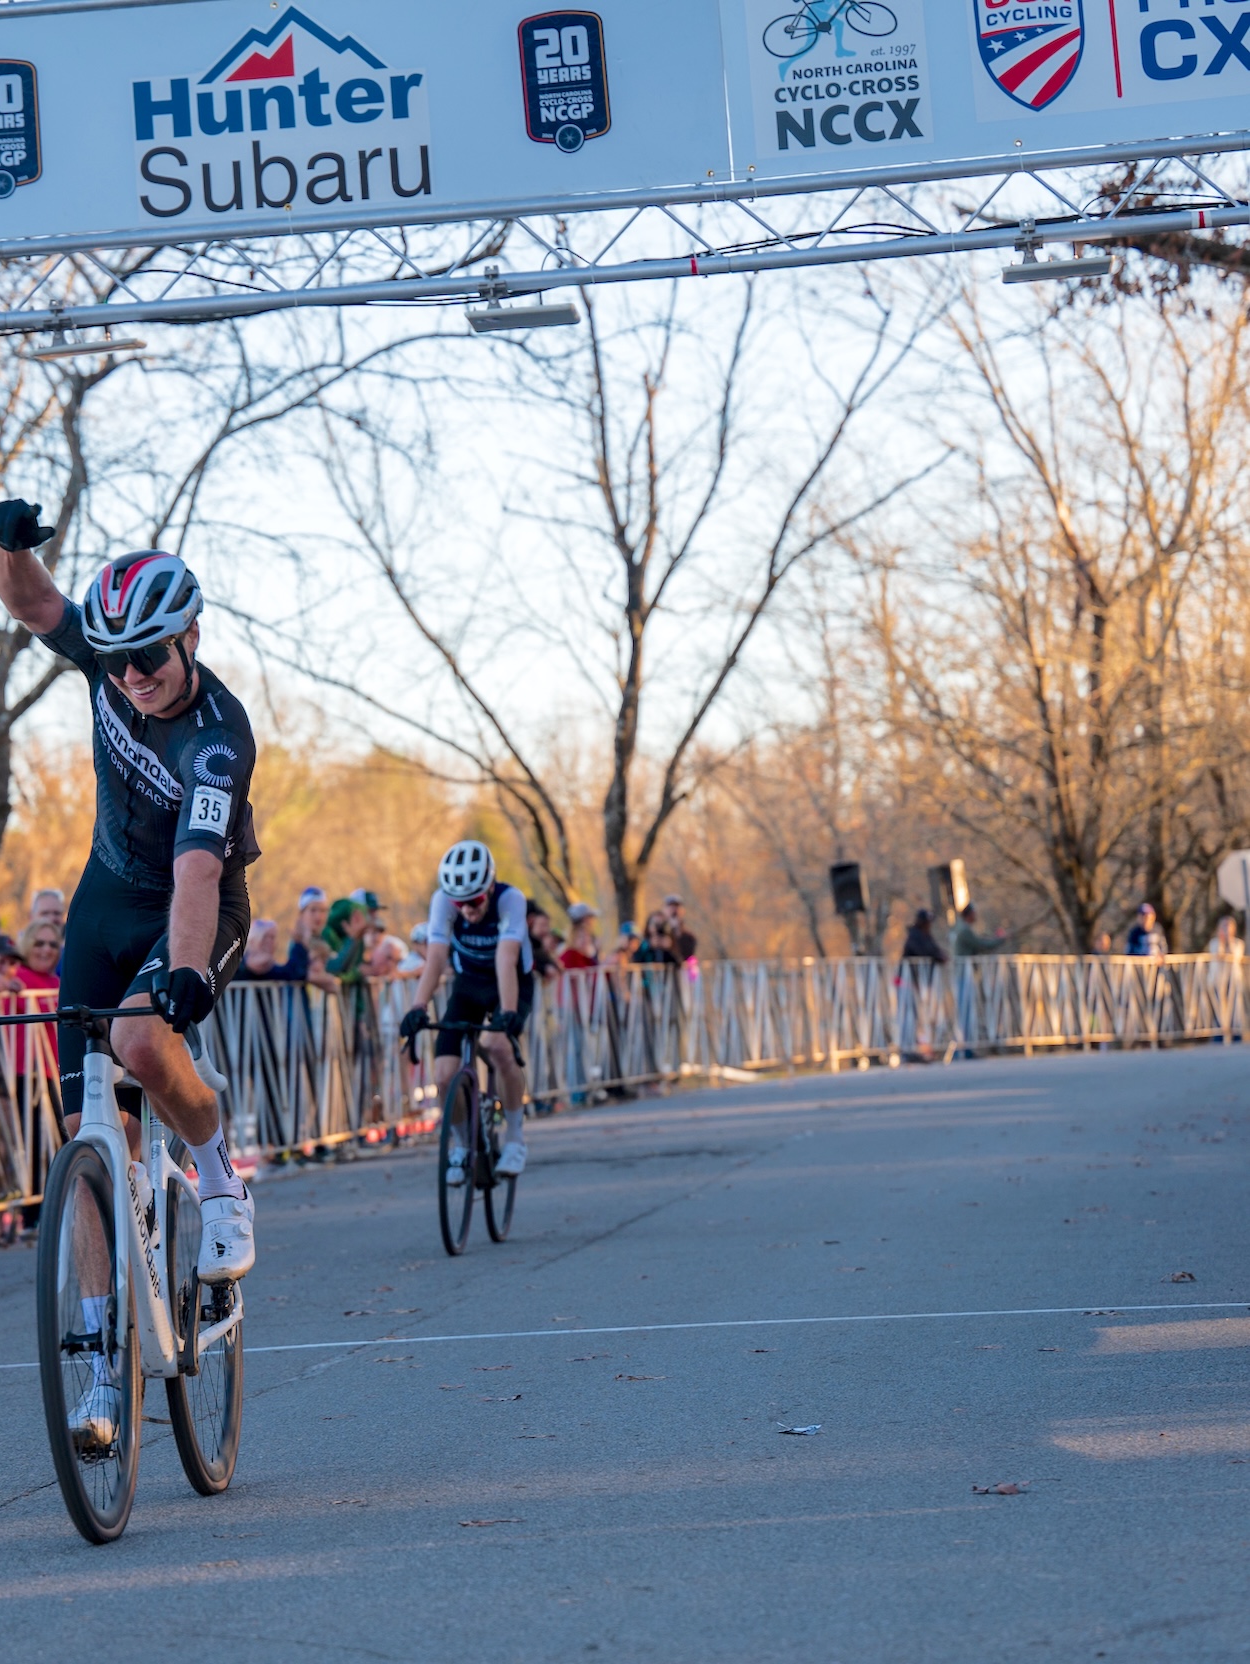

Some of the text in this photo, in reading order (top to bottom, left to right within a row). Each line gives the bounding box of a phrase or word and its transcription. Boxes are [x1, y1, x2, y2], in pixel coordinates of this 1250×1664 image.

[986, 6, 1073, 26] CYCLING
[533, 25, 590, 69] 20
[870, 43, 917, 57] est. 1997
[1139, 12, 1250, 81] CX
[537, 65, 592, 85] YEARS
[792, 58, 918, 80] NORTH CAROLINA
[132, 67, 423, 141] Hunter
[540, 102, 595, 123] NCGP
[775, 97, 925, 151] NCCX
[139, 140, 432, 218] Subaru
[198, 797, 222, 822] 35
[126, 1164, 161, 1298] cannondale
